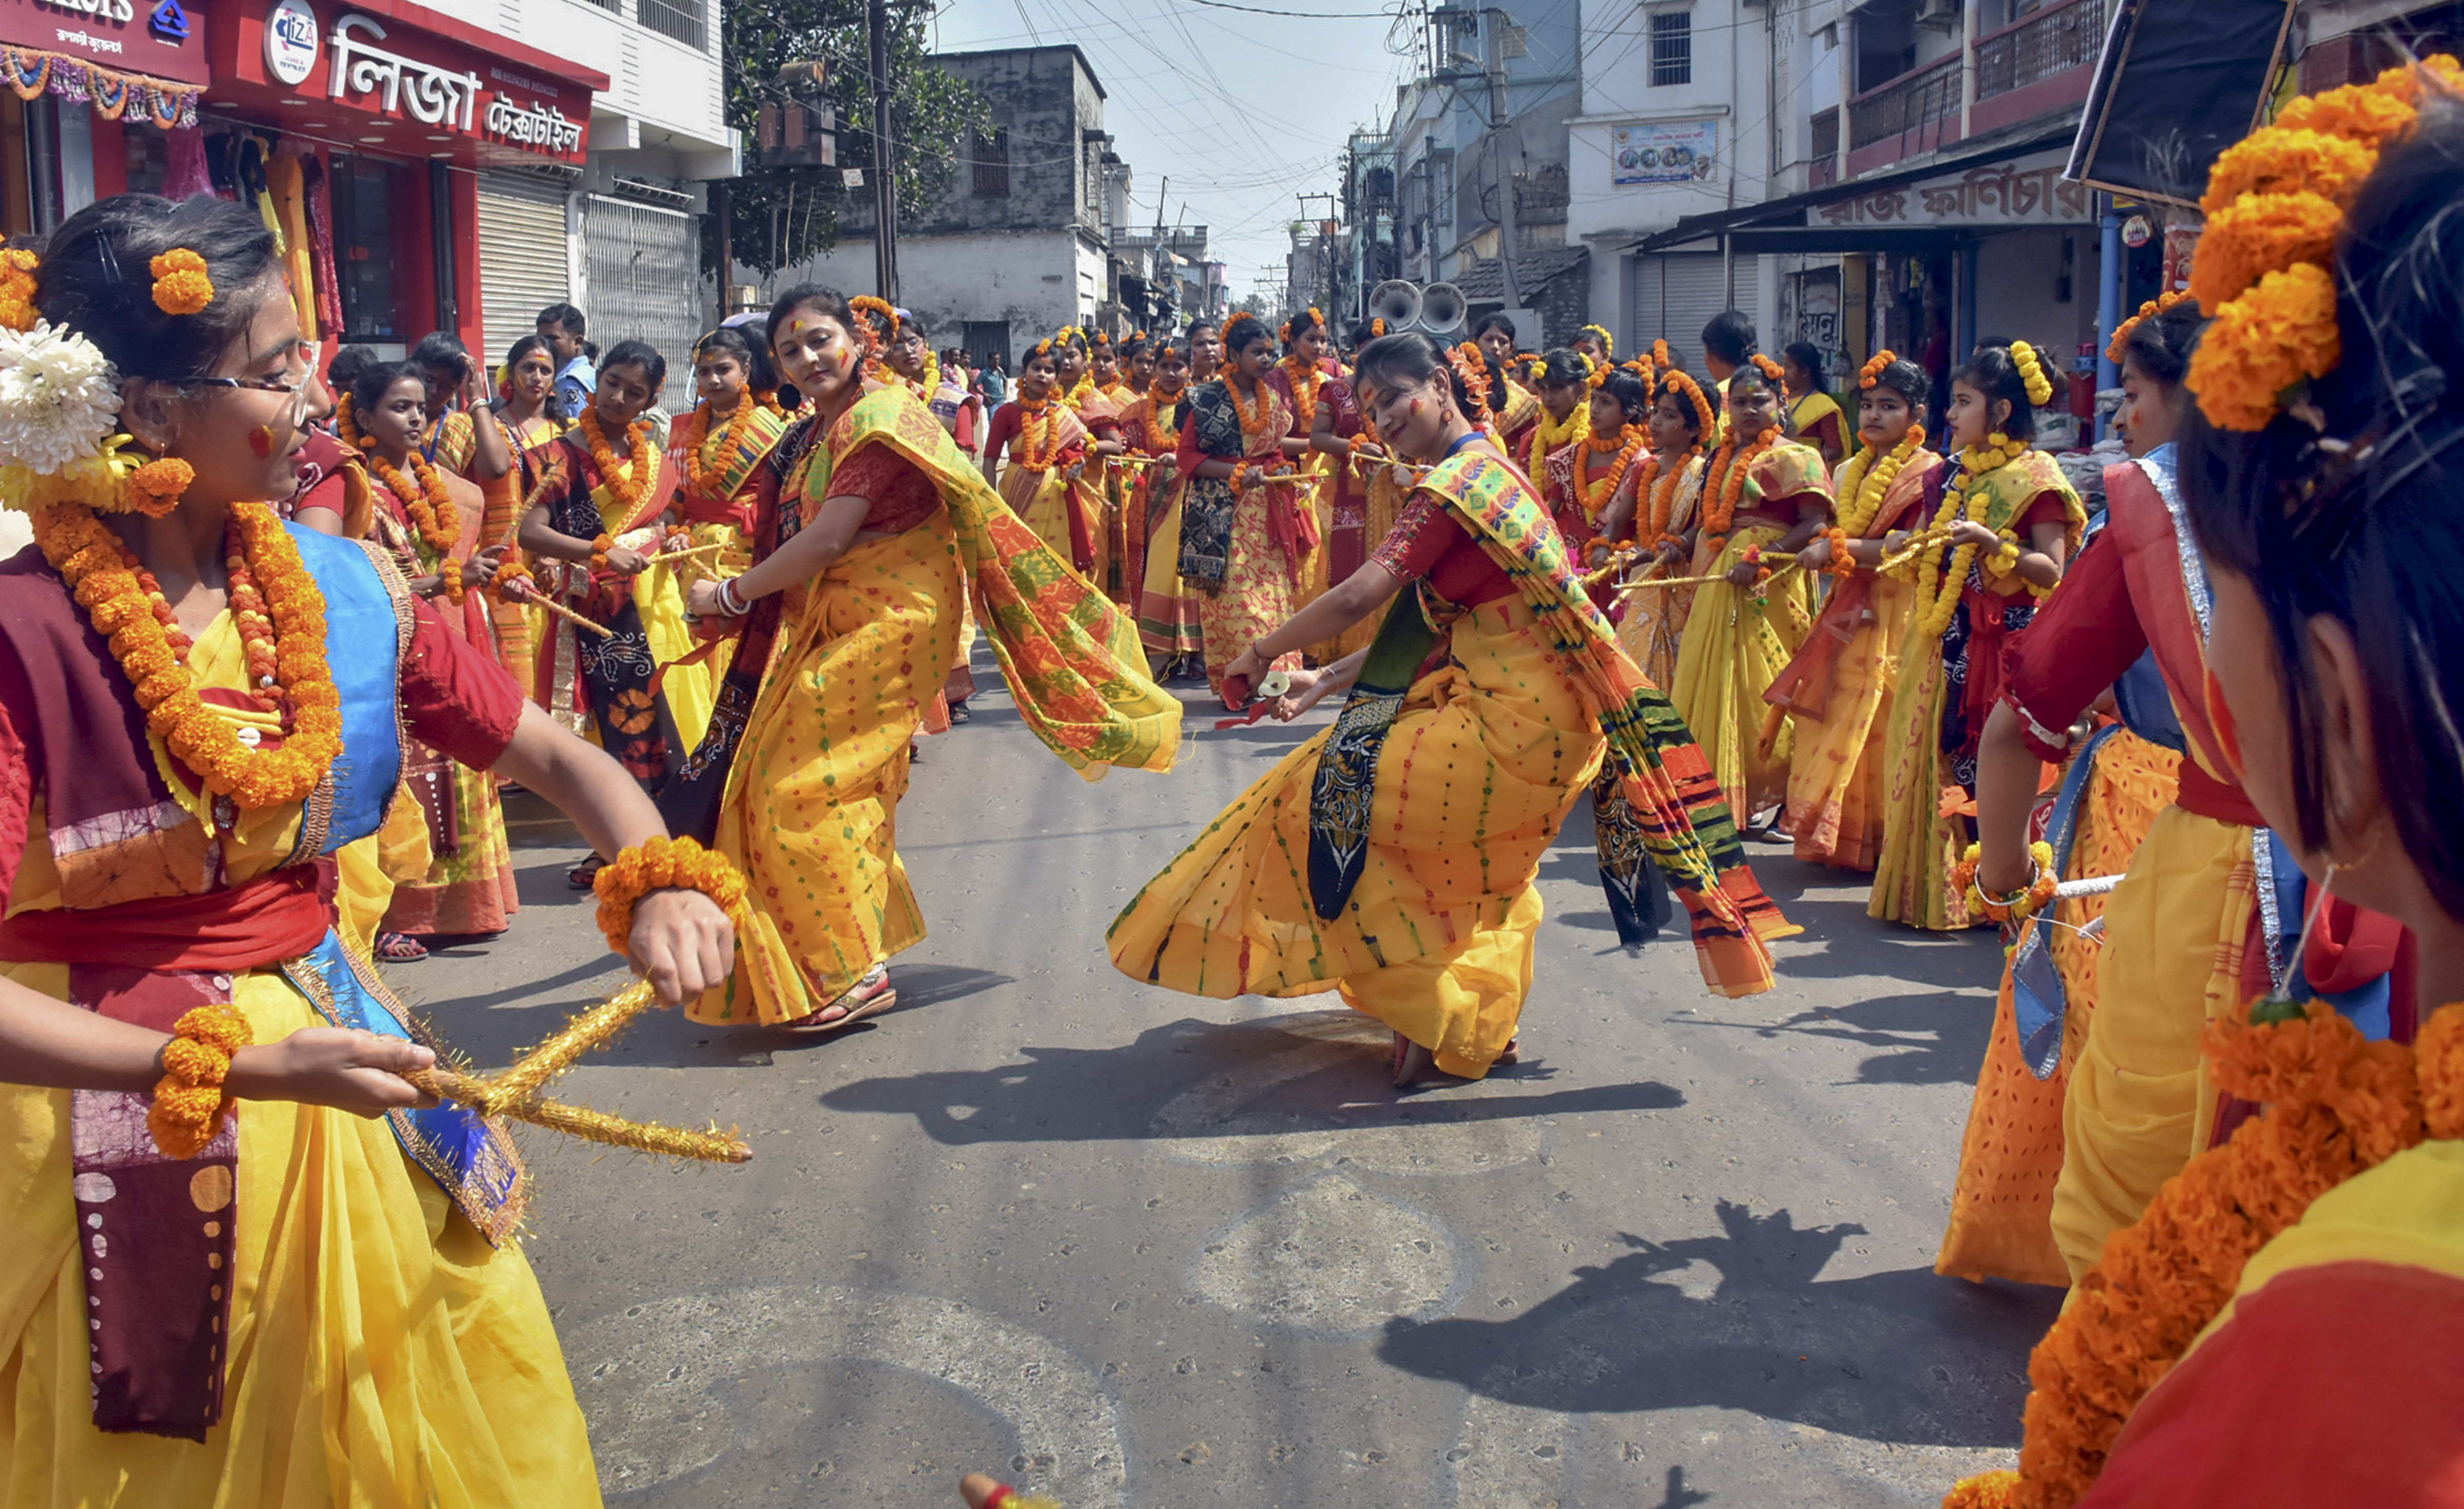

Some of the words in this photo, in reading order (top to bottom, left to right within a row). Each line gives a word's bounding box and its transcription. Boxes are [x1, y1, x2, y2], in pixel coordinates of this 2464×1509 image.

[330, 13, 483, 131] লিজা
[487, 90, 583, 152] টেক্সটাইল
[1817, 182, 1911, 225] রাজ
